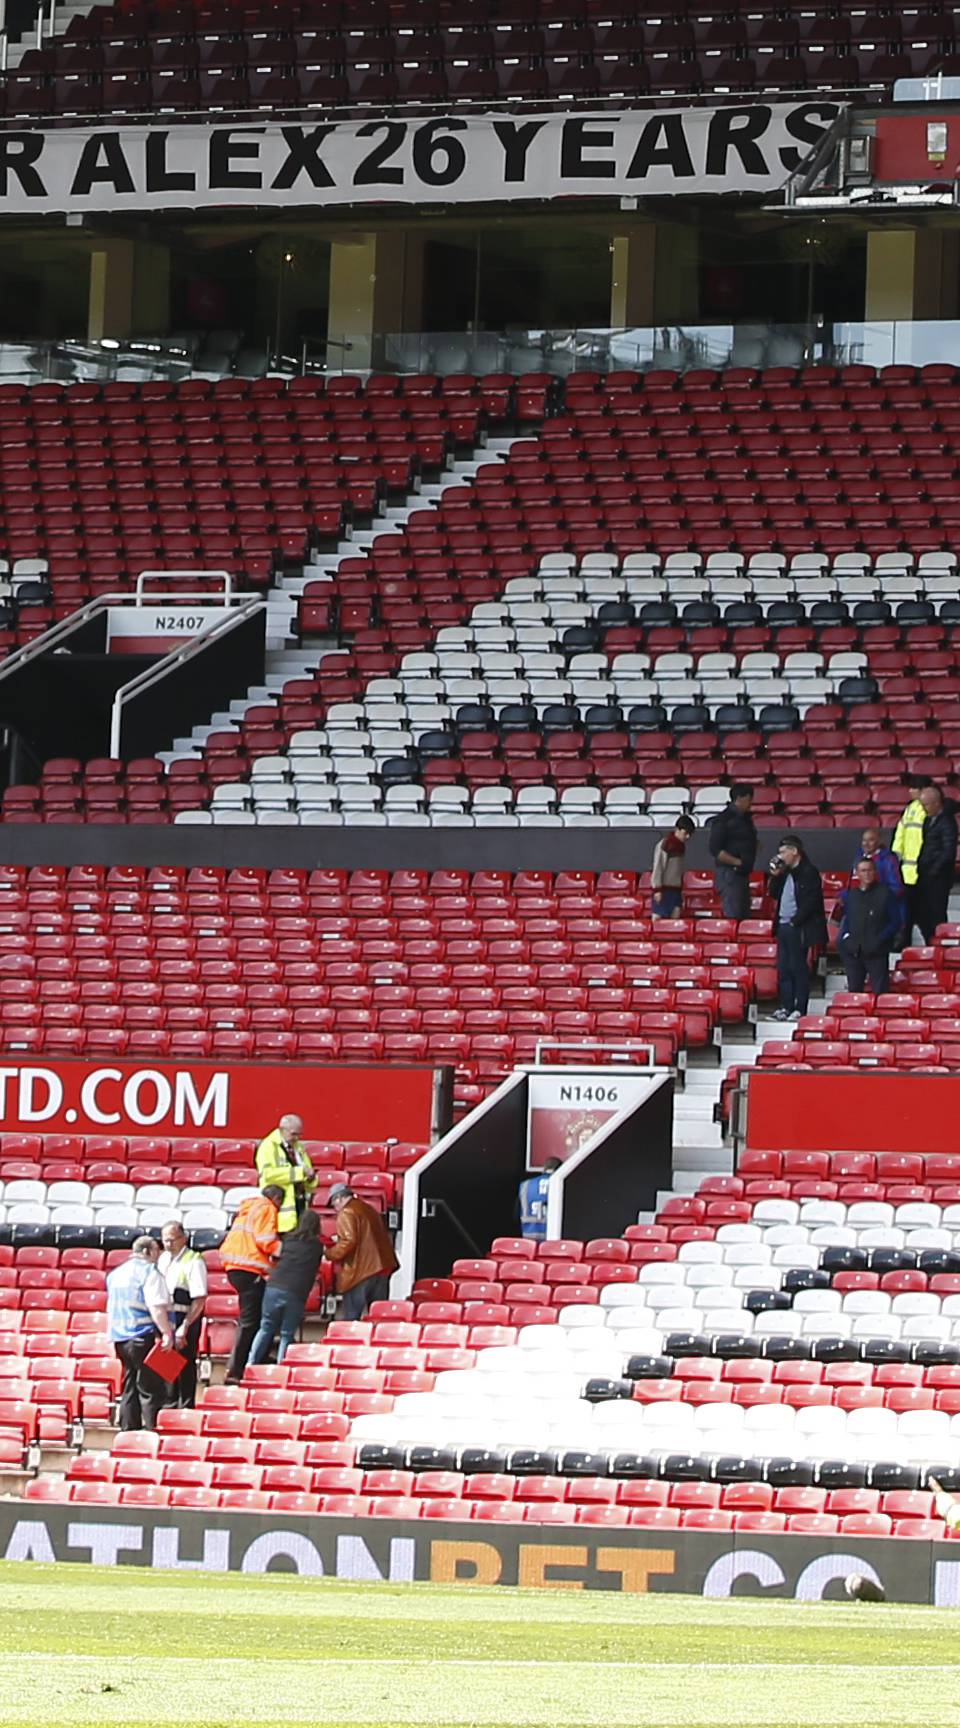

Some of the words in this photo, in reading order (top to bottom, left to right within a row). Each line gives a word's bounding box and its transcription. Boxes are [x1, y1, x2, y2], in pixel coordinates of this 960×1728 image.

[0, 132, 49, 197] R
[70, 124, 341, 196] ALEX
[353, 117, 467, 186] 26
[492, 102, 840, 183] YEARS
[155, 616, 205, 630] N2407
[560, 1086, 618, 1101] N1406
